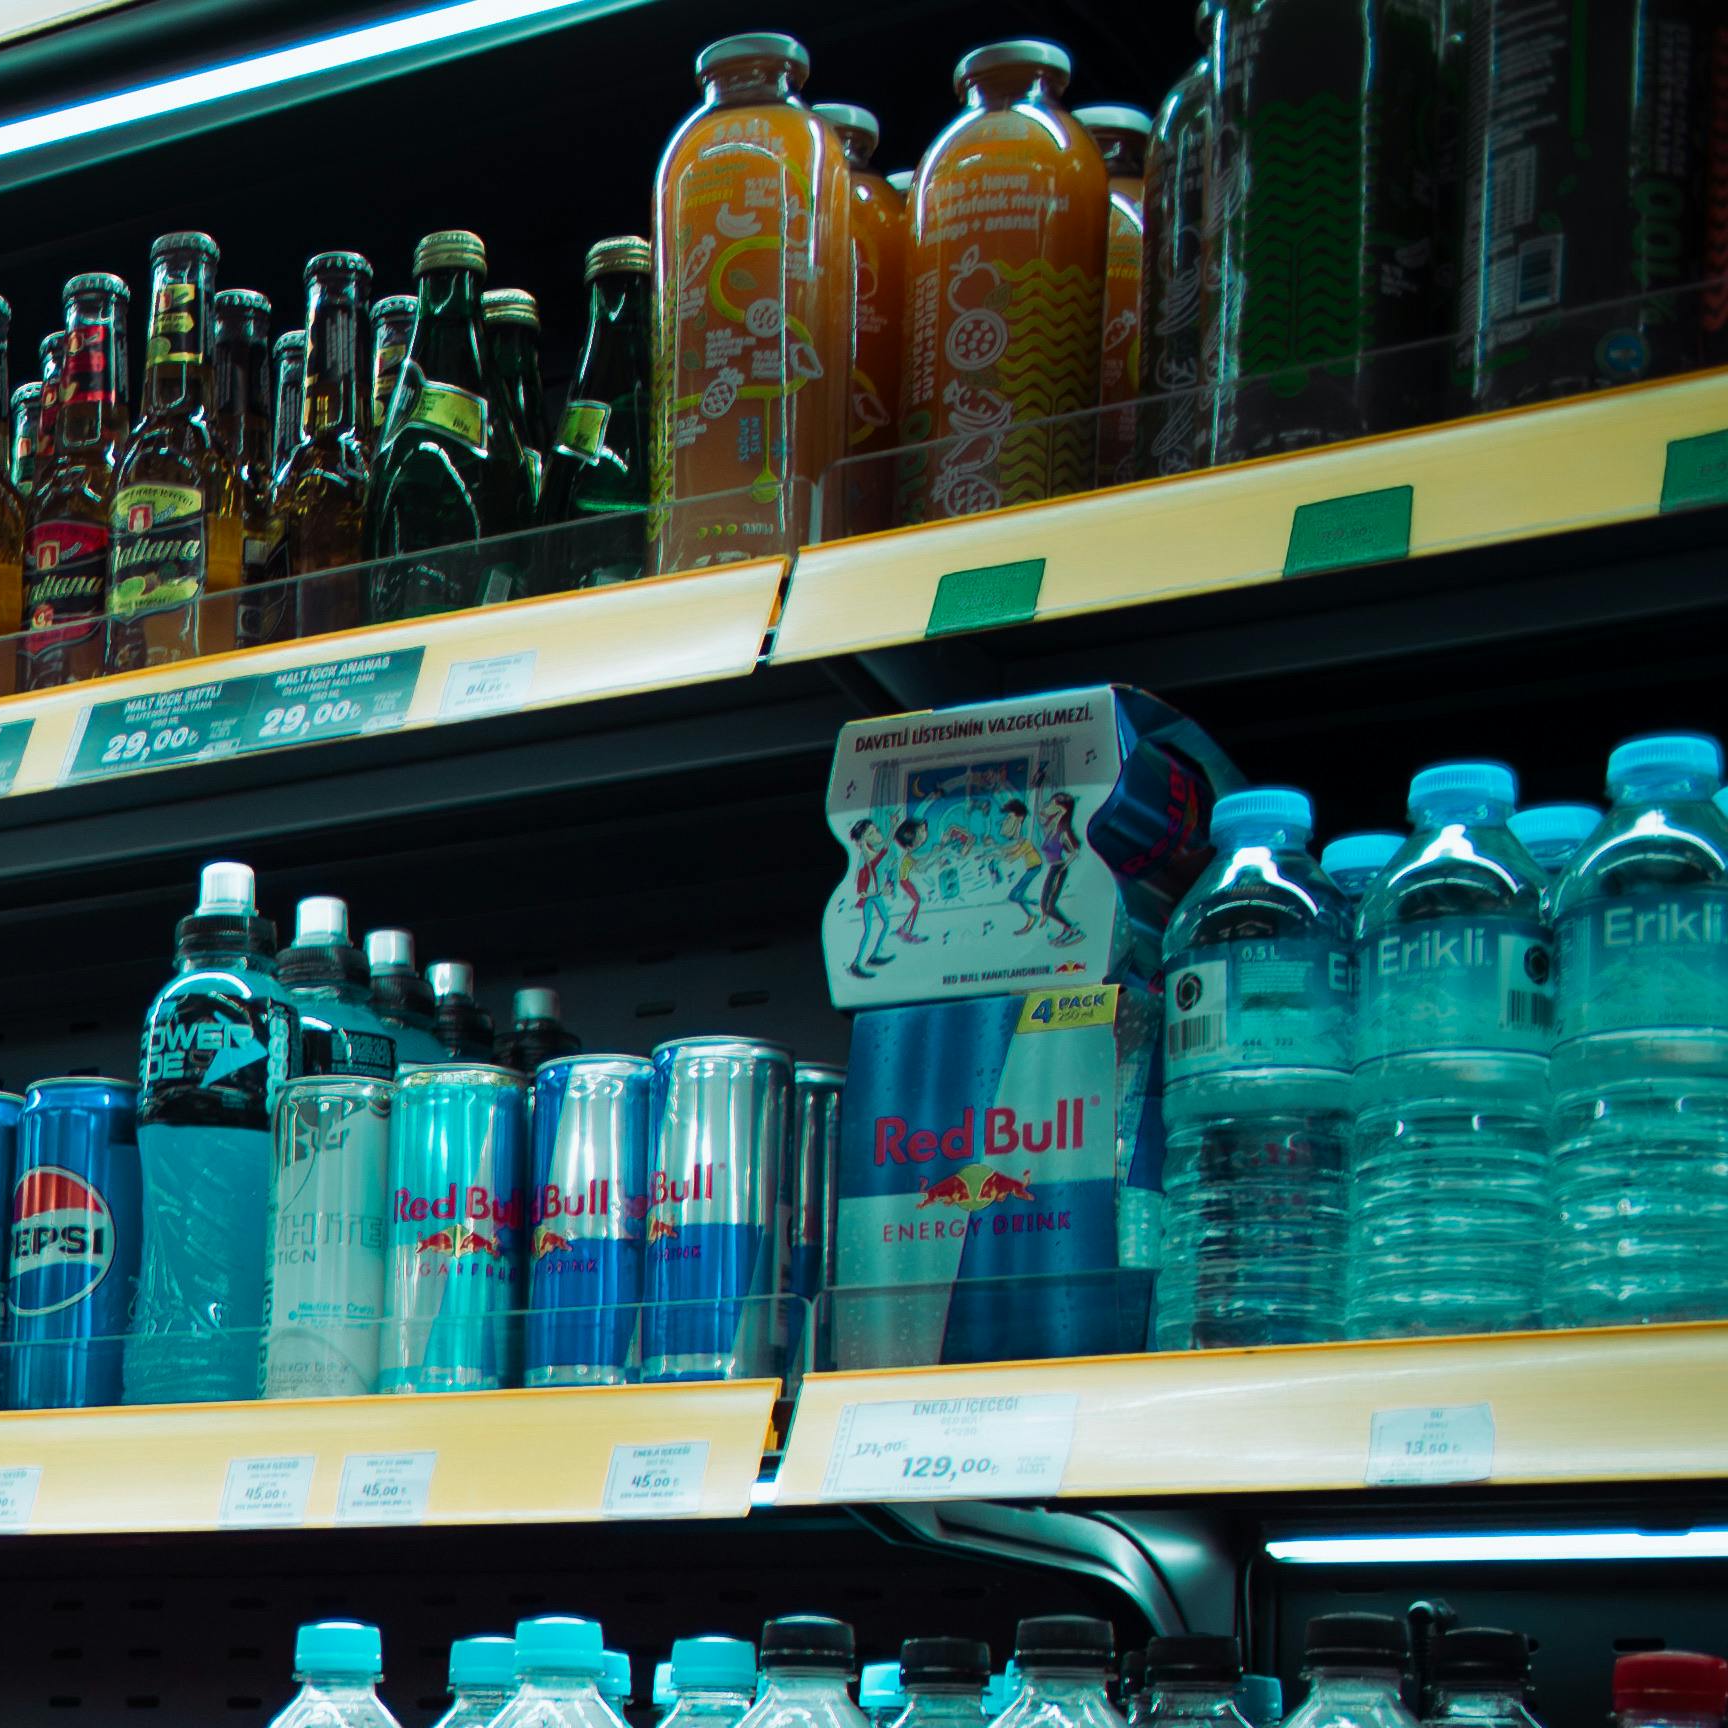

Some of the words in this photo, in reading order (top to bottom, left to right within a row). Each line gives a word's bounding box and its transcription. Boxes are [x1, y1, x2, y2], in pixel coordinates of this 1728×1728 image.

[854, 727, 909, 754] DAVETLİ
[910, 720, 984, 746] LİSTESİNİN
[987, 702, 1095, 735] VAZGEÇİLMEZİ.
[1603, 902, 1726, 947] Erikli
[1377, 927, 1485, 977] Erikli
[1029, 997, 1054, 1024] 4
[1057, 991, 1106, 1010] PACK
[874, 1105, 975, 1166] Red
[983, 1096, 1085, 1157] Bull
[394, 1182, 457, 1224] Red
[543, 1178, 609, 1220] Bull
[647, 1161, 713, 1206] Bull
[13, 1225, 105, 1259] EPSI
[882, 1215, 982, 1243] ENERGY
[991, 1209, 1073, 1237] DRINK
[276, 1246, 318, 1265] TION
